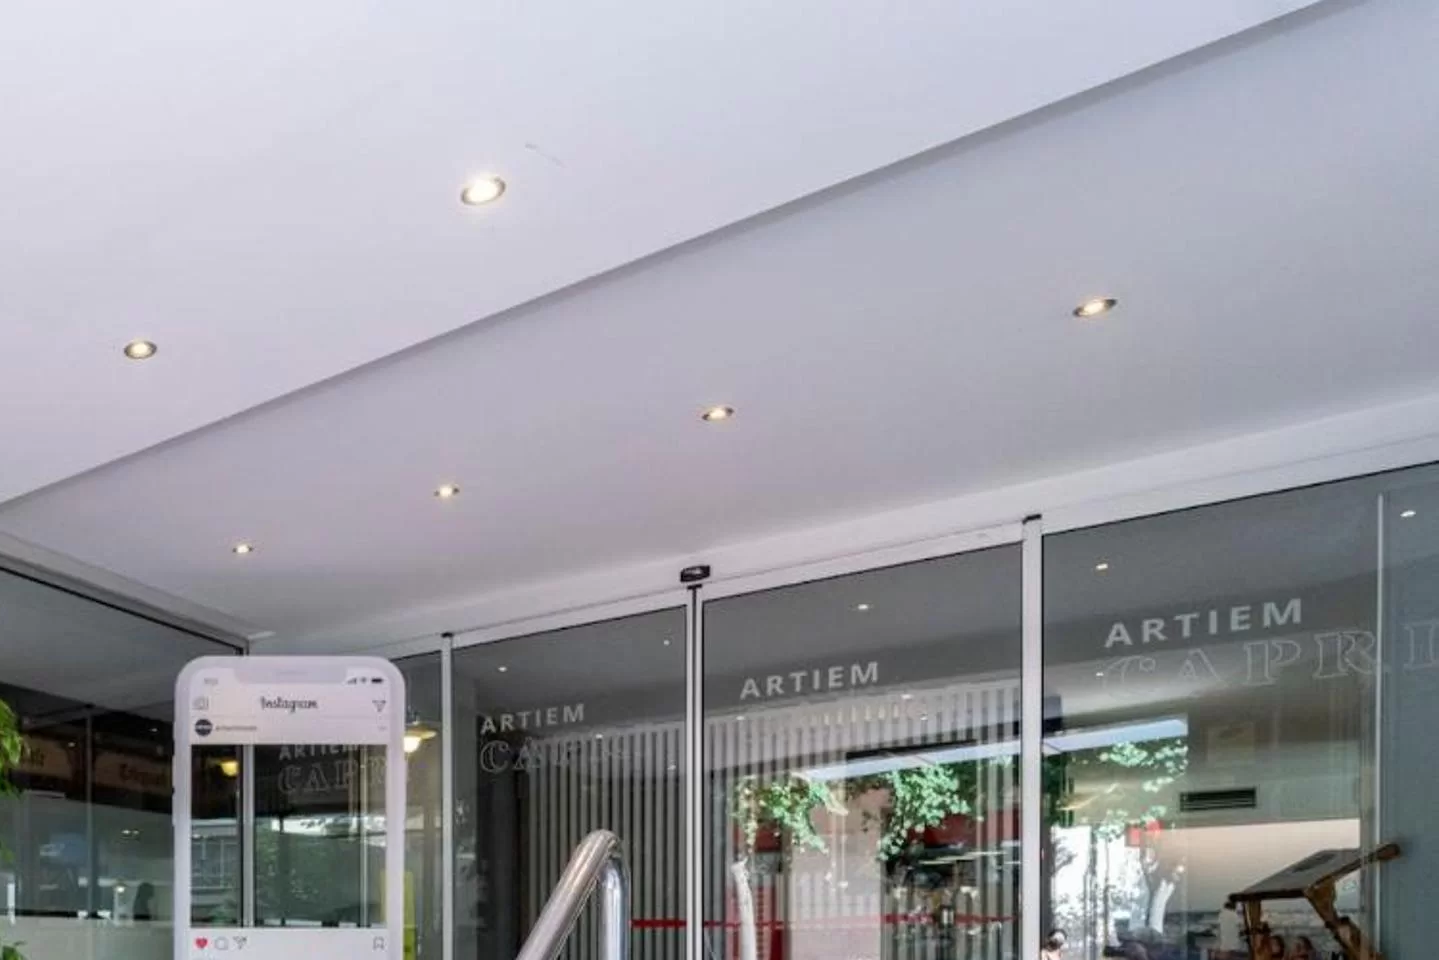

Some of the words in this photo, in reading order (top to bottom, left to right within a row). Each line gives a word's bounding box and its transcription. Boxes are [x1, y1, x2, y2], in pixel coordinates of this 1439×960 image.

[1104, 598, 1302, 648] ARTIEM
[740, 661, 879, 701] ARTIEM
[260, 696, 319, 713] Instagram
[480, 703, 585, 734] ARTIEM
